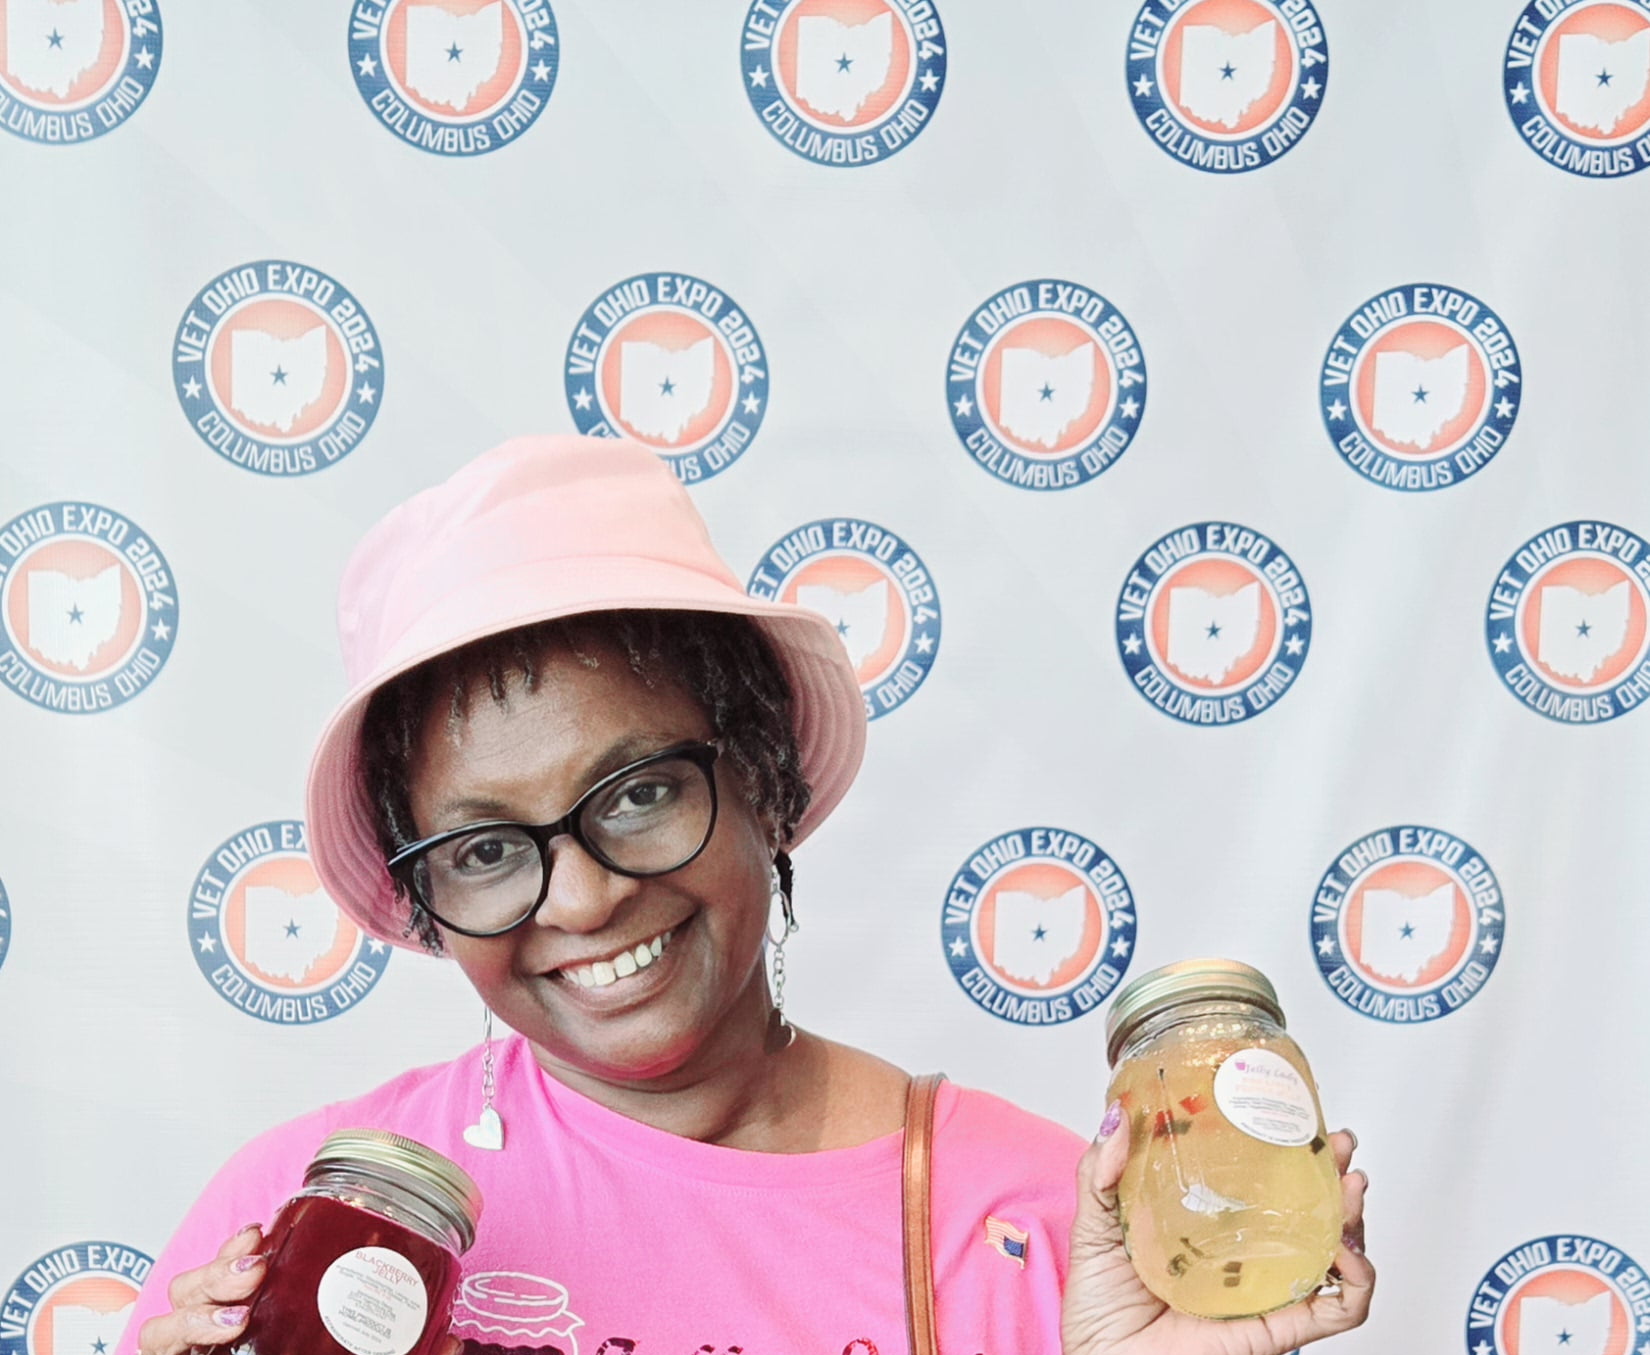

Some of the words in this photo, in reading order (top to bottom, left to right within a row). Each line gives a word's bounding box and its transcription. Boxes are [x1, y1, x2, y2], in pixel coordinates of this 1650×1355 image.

[127, 0, 159, 38] 24
[352, 0, 387, 40] VE
[746, 0, 779, 52] VET
[1131, 8, 1165, 61] VET
[1508, 17, 1542, 69] VET
[0, 95, 94, 141] LUMBUS
[95, 77, 146, 128] OHIO
[371, 89, 492, 153] COLUMBUS
[493, 90, 544, 141] OHIO
[762, 99, 880, 163] COLUMBUS
[880, 100, 931, 151] OHIO
[1146, 108, 1261, 170] COLUMBUS
[1262, 107, 1312, 158] OHIO
[1522, 114, 1637, 175] COLUMBUS
[179, 313, 213, 364] VET
[203, 268, 260, 316] OHIO
[265, 264, 336, 305] EXPO
[329, 298, 383, 374] 2024
[570, 324, 604, 375] VET
[595, 280, 650, 328] OHIO
[656, 276, 724, 317] EXPO
[717, 310, 768, 385] 2024
[952, 333, 985, 383] VET
[977, 288, 1032, 336] OHIO
[1037, 283, 1104, 323] EXPO
[1097, 315, 1146, 389] 2024
[1325, 337, 1360, 388] VET
[1351, 292, 1407, 340] OHIO
[1412, 287, 1480, 325] EXPO
[1472, 317, 1521, 389] 2024
[196, 410, 317, 472] COLUMBUS
[318, 412, 369, 462] OHIO
[702, 422, 753, 471] OHIO
[965, 428, 1080, 487] COLUMBUS
[1081, 427, 1131, 475] OHIO
[1339, 431, 1453, 487] COLUMBUS
[1454, 427, 1505, 475] OHIO
[1, 510, 56, 559] OHIO
[61, 506, 130, 545] EXPO
[124, 537, 176, 611] 2024
[749, 566, 778, 604] ET
[771, 526, 826, 572] OHIO
[831, 522, 899, 561] EXPO
[891, 554, 940, 625] 2024
[1121, 573, 1154, 622] VET
[1146, 529, 1199, 576] OHIO
[1204, 525, 1270, 563] EXPO
[1263, 556, 1311, 627] 2024
[1491, 571, 1525, 620] VET
[1517, 529, 1571, 574] OHIO
[1576, 524, 1643, 563] EXPO
[0, 650, 112, 701] COLUMBUS
[114, 649, 164, 698] OHIO
[874, 661, 925, 708] OHIO
[1134, 665, 1246, 722] COLUMBUS
[1247, 664, 1296, 711] OHIO
[1504, 663, 1615, 720] COLUMBUS
[194, 871, 227, 921] VET
[218, 828, 273, 874] OHIO
[947, 878, 980, 926] VET
[972, 835, 1025, 880] OHIO
[1030, 830, 1095, 867] EXPO
[1088, 860, 1136, 929] 2024
[1315, 876, 1348, 924] VET
[1339, 833, 1393, 878] OHIO
[1398, 828, 1464, 865] EXPO
[1457, 858, 1505, 926] 2024
[211, 964, 329, 1021] COLUMBUS
[330, 963, 380, 1010] OHIO
[961, 967, 1072, 1022] COLUMBUS
[1073, 965, 1121, 1011] OHIO
[1328, 965, 1440, 1020] COLUMBUS
[1441, 962, 1490, 1008] OHIO
[0, 1289, 33, 1339] VET
[24, 1249, 80, 1294] OHIO
[88, 1245, 151, 1283] EXPO
[355, 1250, 418, 1287] BLACKBERRY
[372, 1265, 401, 1285] JELLY
[1471, 1283, 1504, 1329] VET
[1496, 1242, 1550, 1286] OHIO
[1555, 1238, 1623, 1274] EXPO
